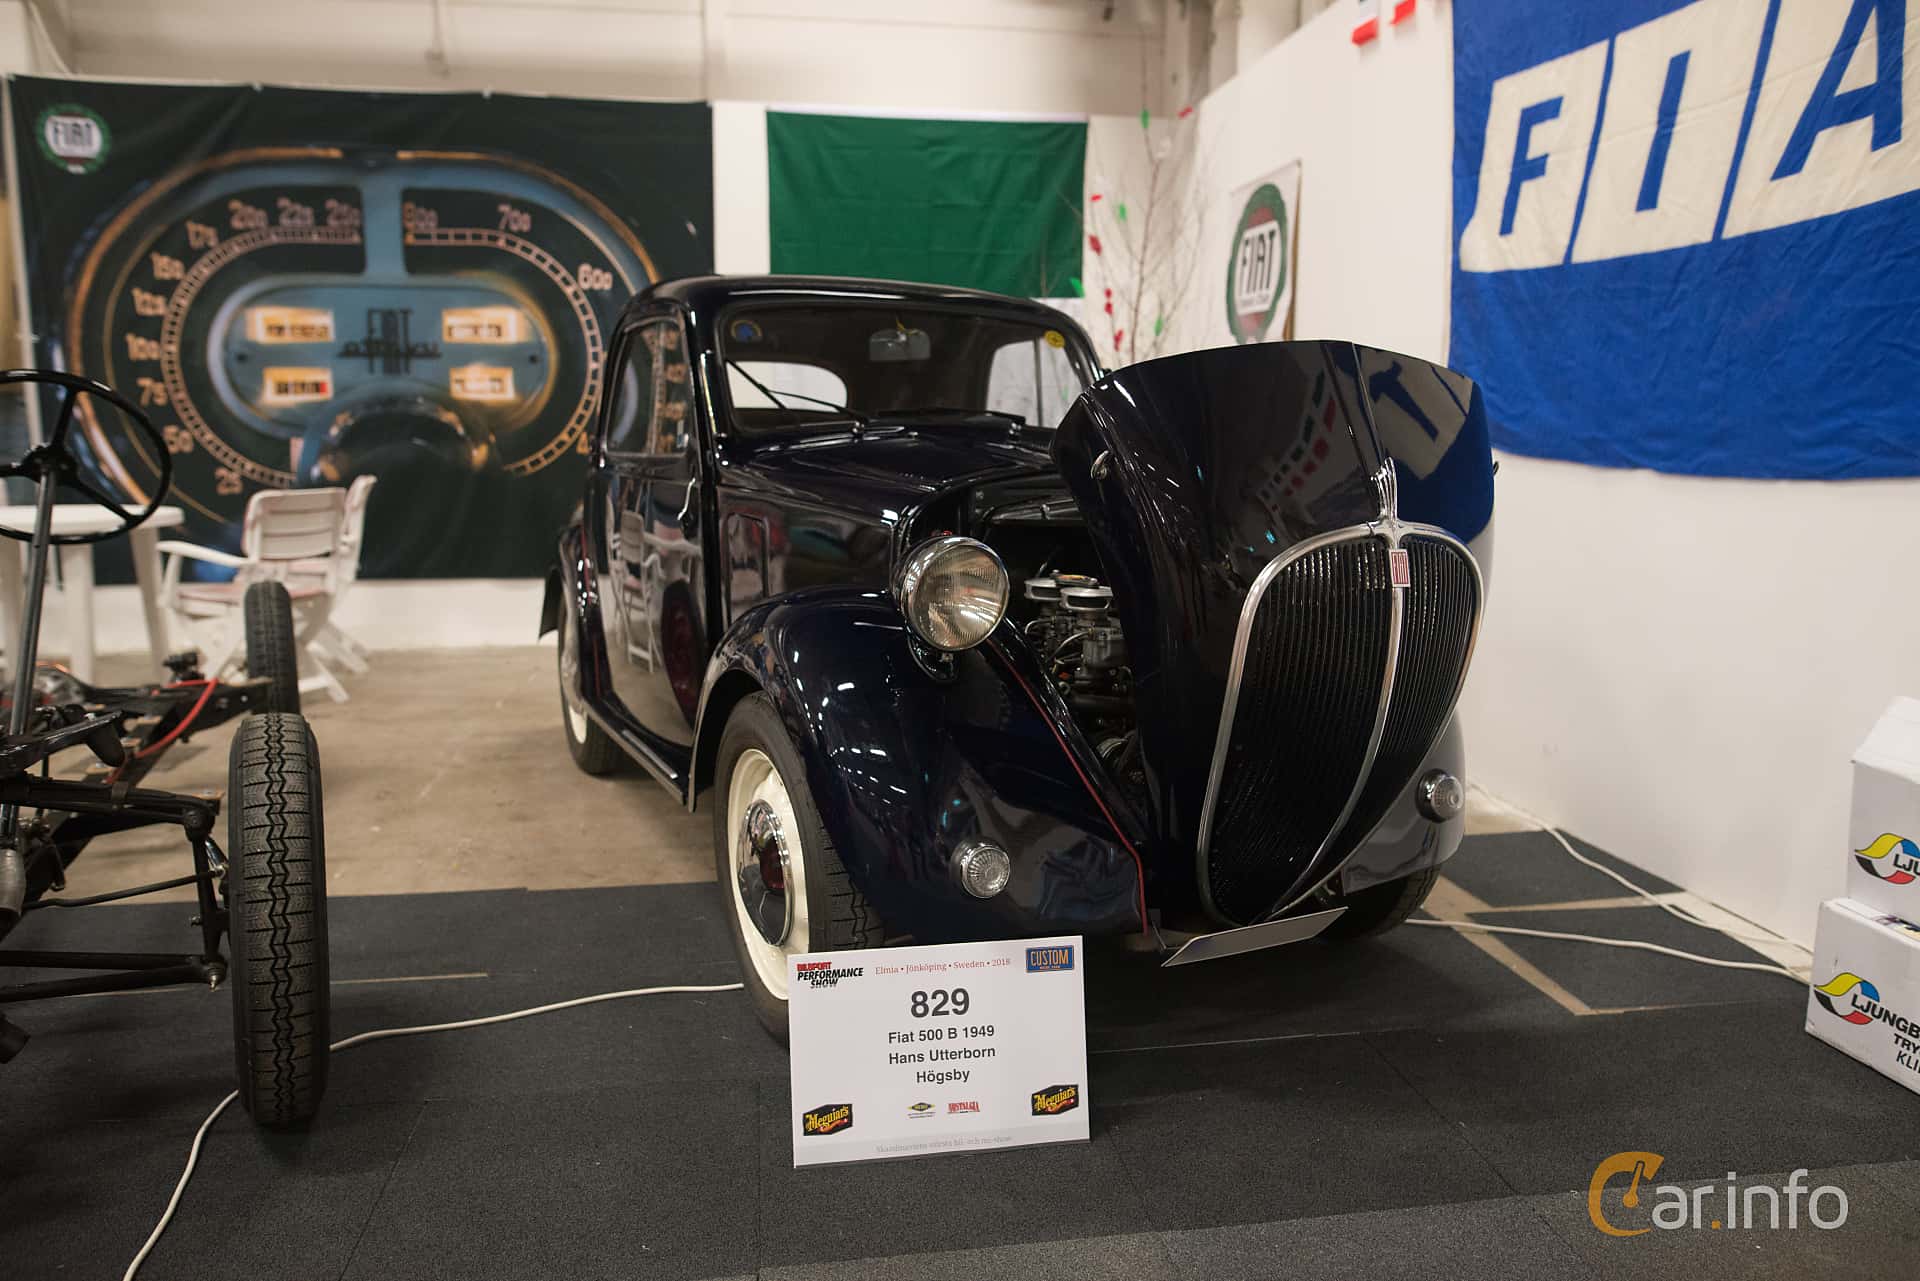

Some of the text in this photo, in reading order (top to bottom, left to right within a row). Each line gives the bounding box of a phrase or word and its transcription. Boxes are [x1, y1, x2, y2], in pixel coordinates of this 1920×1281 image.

[53, 121, 92, 146] FIAT
[1239, 229, 1276, 297] FIAT
[577, 263, 613, 291] 600
[875, 957, 1011, 975] Elmia Jönköping Sweden 2018
[1031, 949, 1069, 967] CUSTOM
[797, 967, 864, 982] PERFORMANCE
[811, 978, 839, 989] SHOW
[911, 987, 970, 1018] 829
[888, 1024, 995, 1044] Fiat 500 B 1949
[889, 1047, 996, 1065] Hans Utterborn
[1896, 1050, 1920, 1074] KLI
[916, 1068, 970, 1085] Högsby
[1032, 1086, 1077, 1112] Meguiar's
[804, 1105, 850, 1132] Meguiar's
